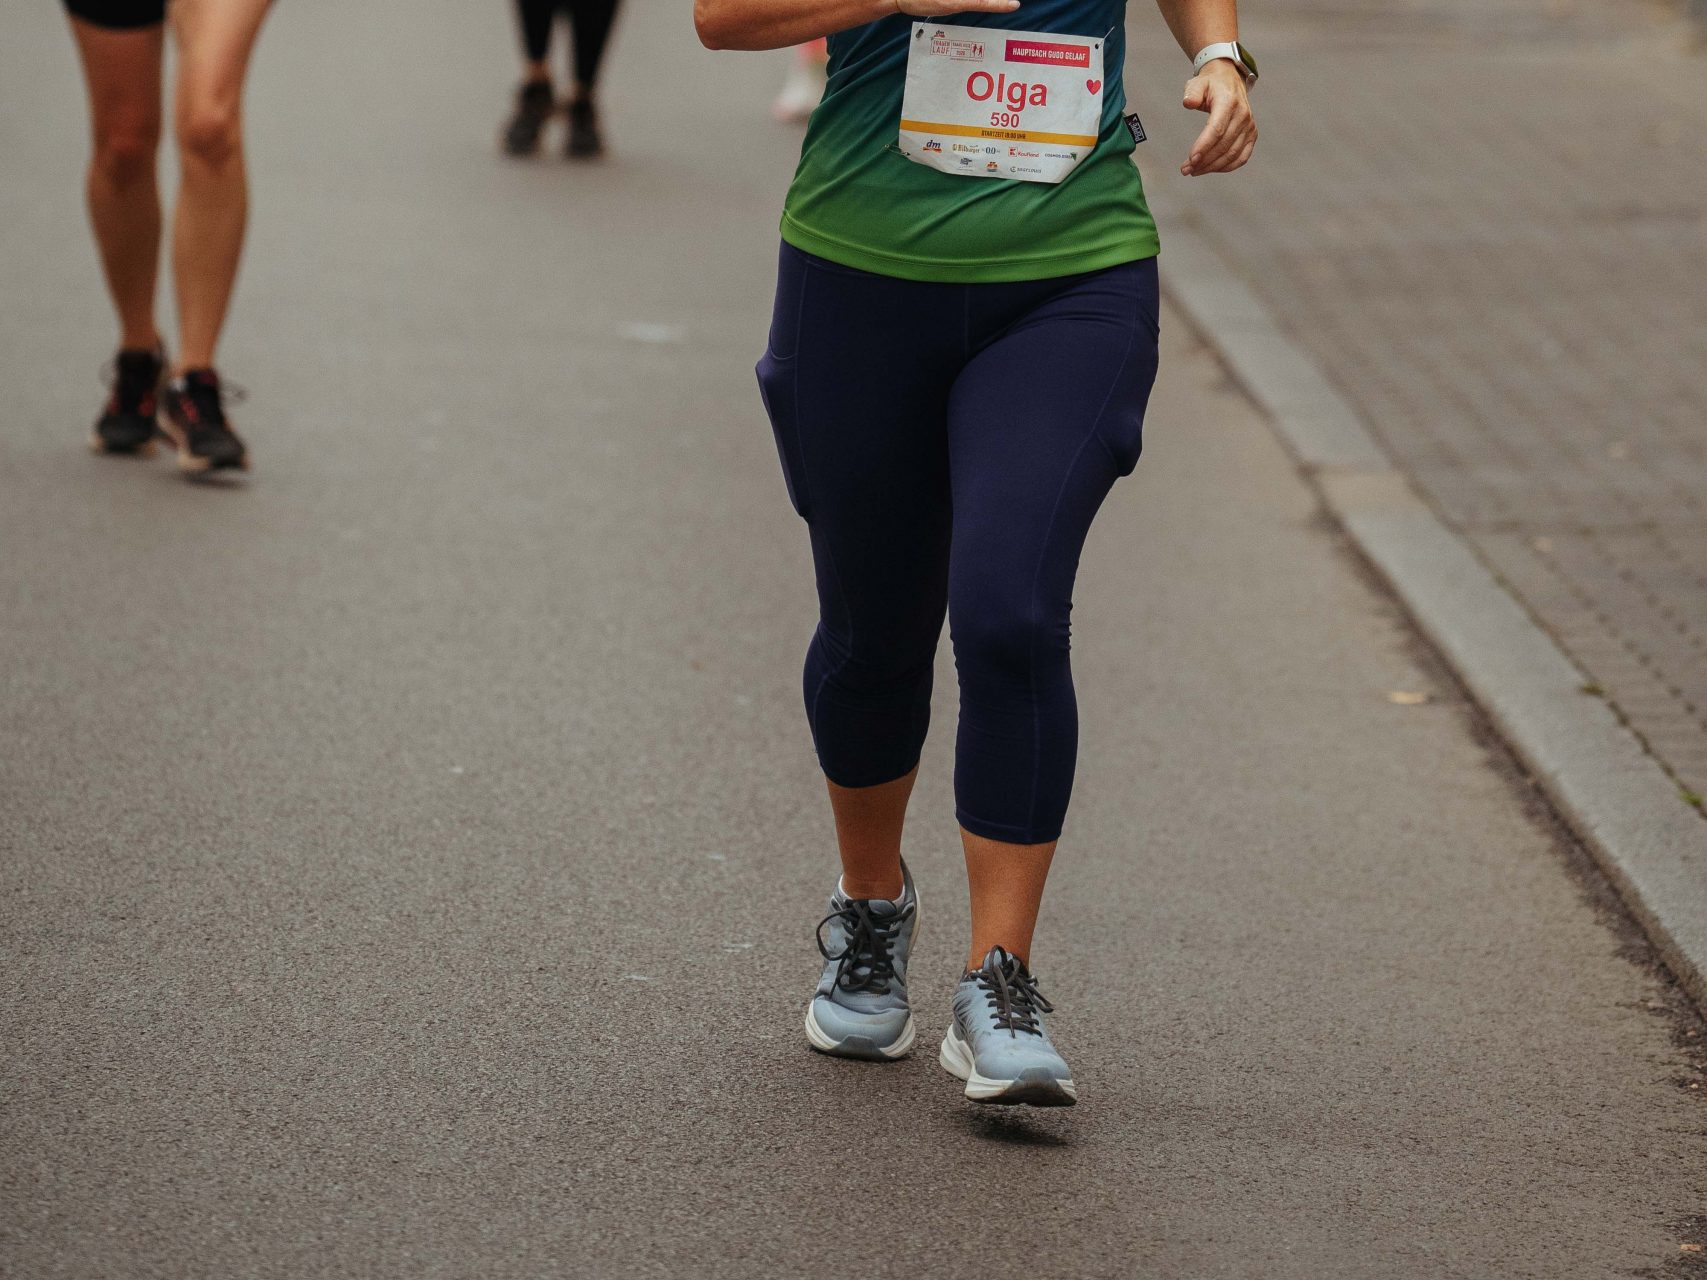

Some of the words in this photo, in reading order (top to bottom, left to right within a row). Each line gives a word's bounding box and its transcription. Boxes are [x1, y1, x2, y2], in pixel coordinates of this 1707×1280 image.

[1012, 48, 1047, 58] HAUPTSACH
[966, 71, 1048, 113] Olga
[990, 112, 1020, 128] 590
